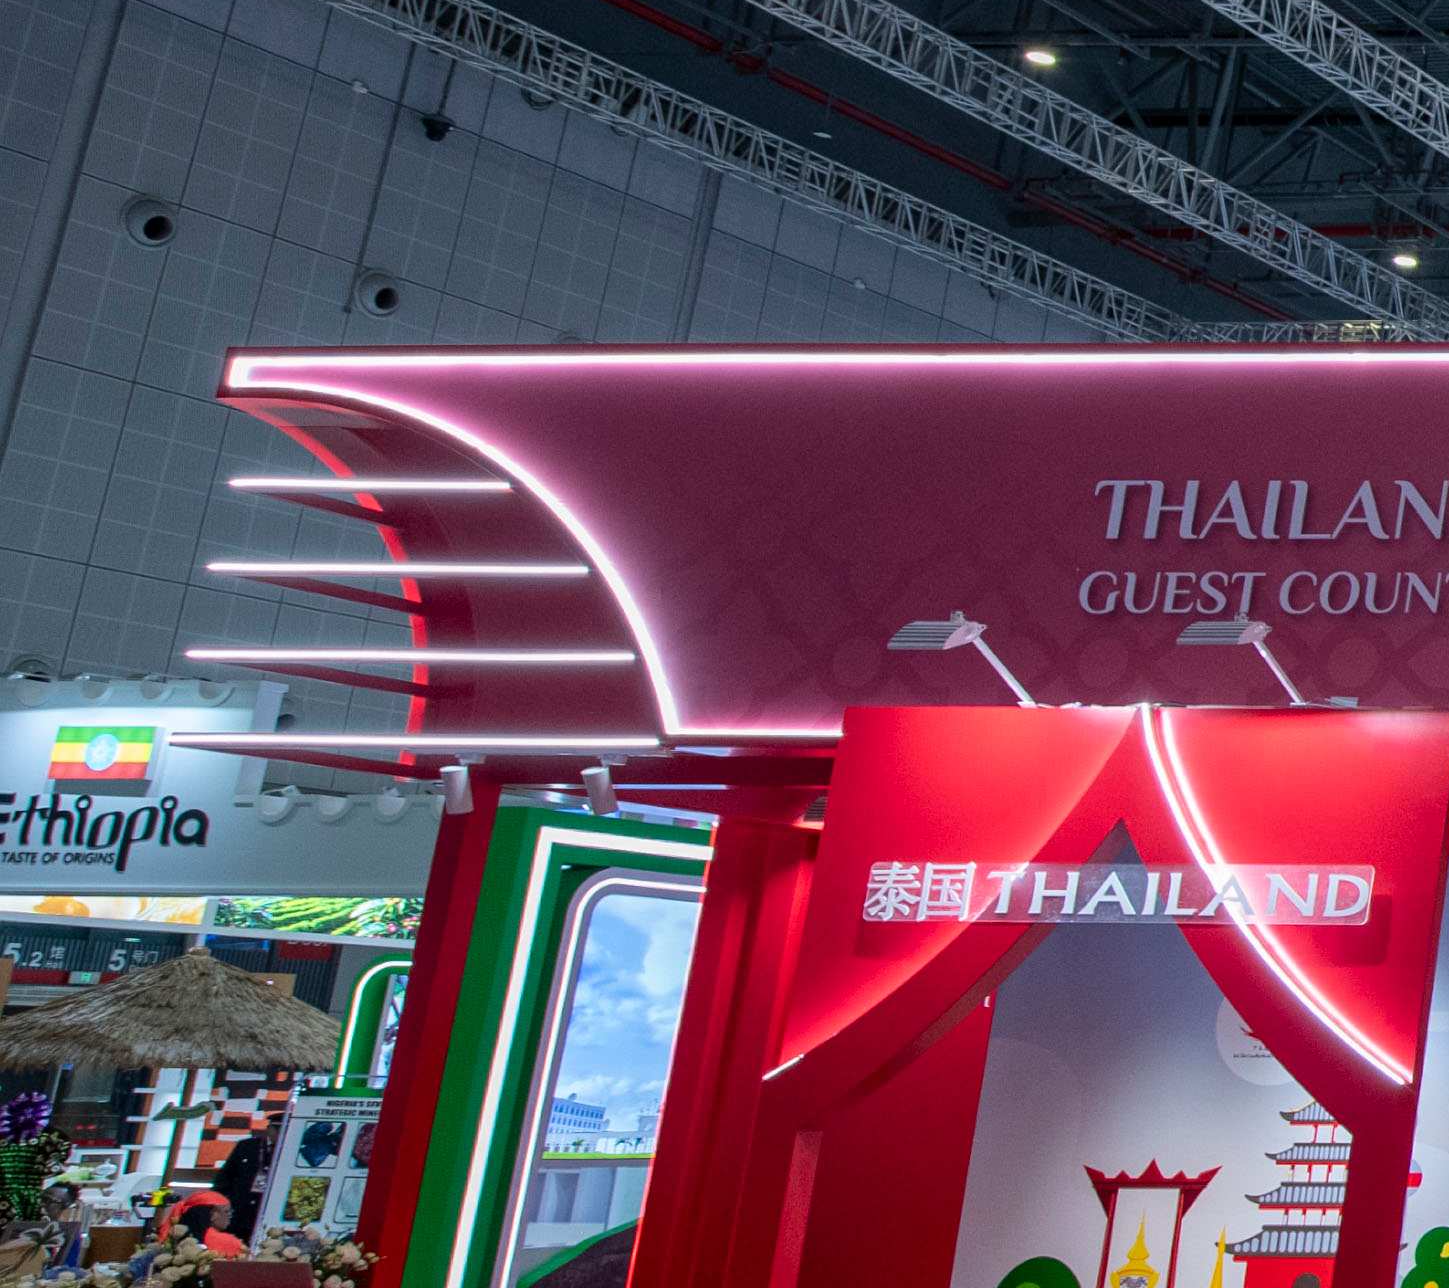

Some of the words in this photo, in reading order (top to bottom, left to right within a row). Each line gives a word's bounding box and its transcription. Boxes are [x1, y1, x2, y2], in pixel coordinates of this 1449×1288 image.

[1077, 570, 1266, 617] GUEST
[2, 851, 39, 864] TASTE
[42, 851, 59, 864] OF
[63, 851, 116, 864] ORIGINS
[862, 861, 976, 923] 泰国
[987, 869, 1370, 919] THAILAND
